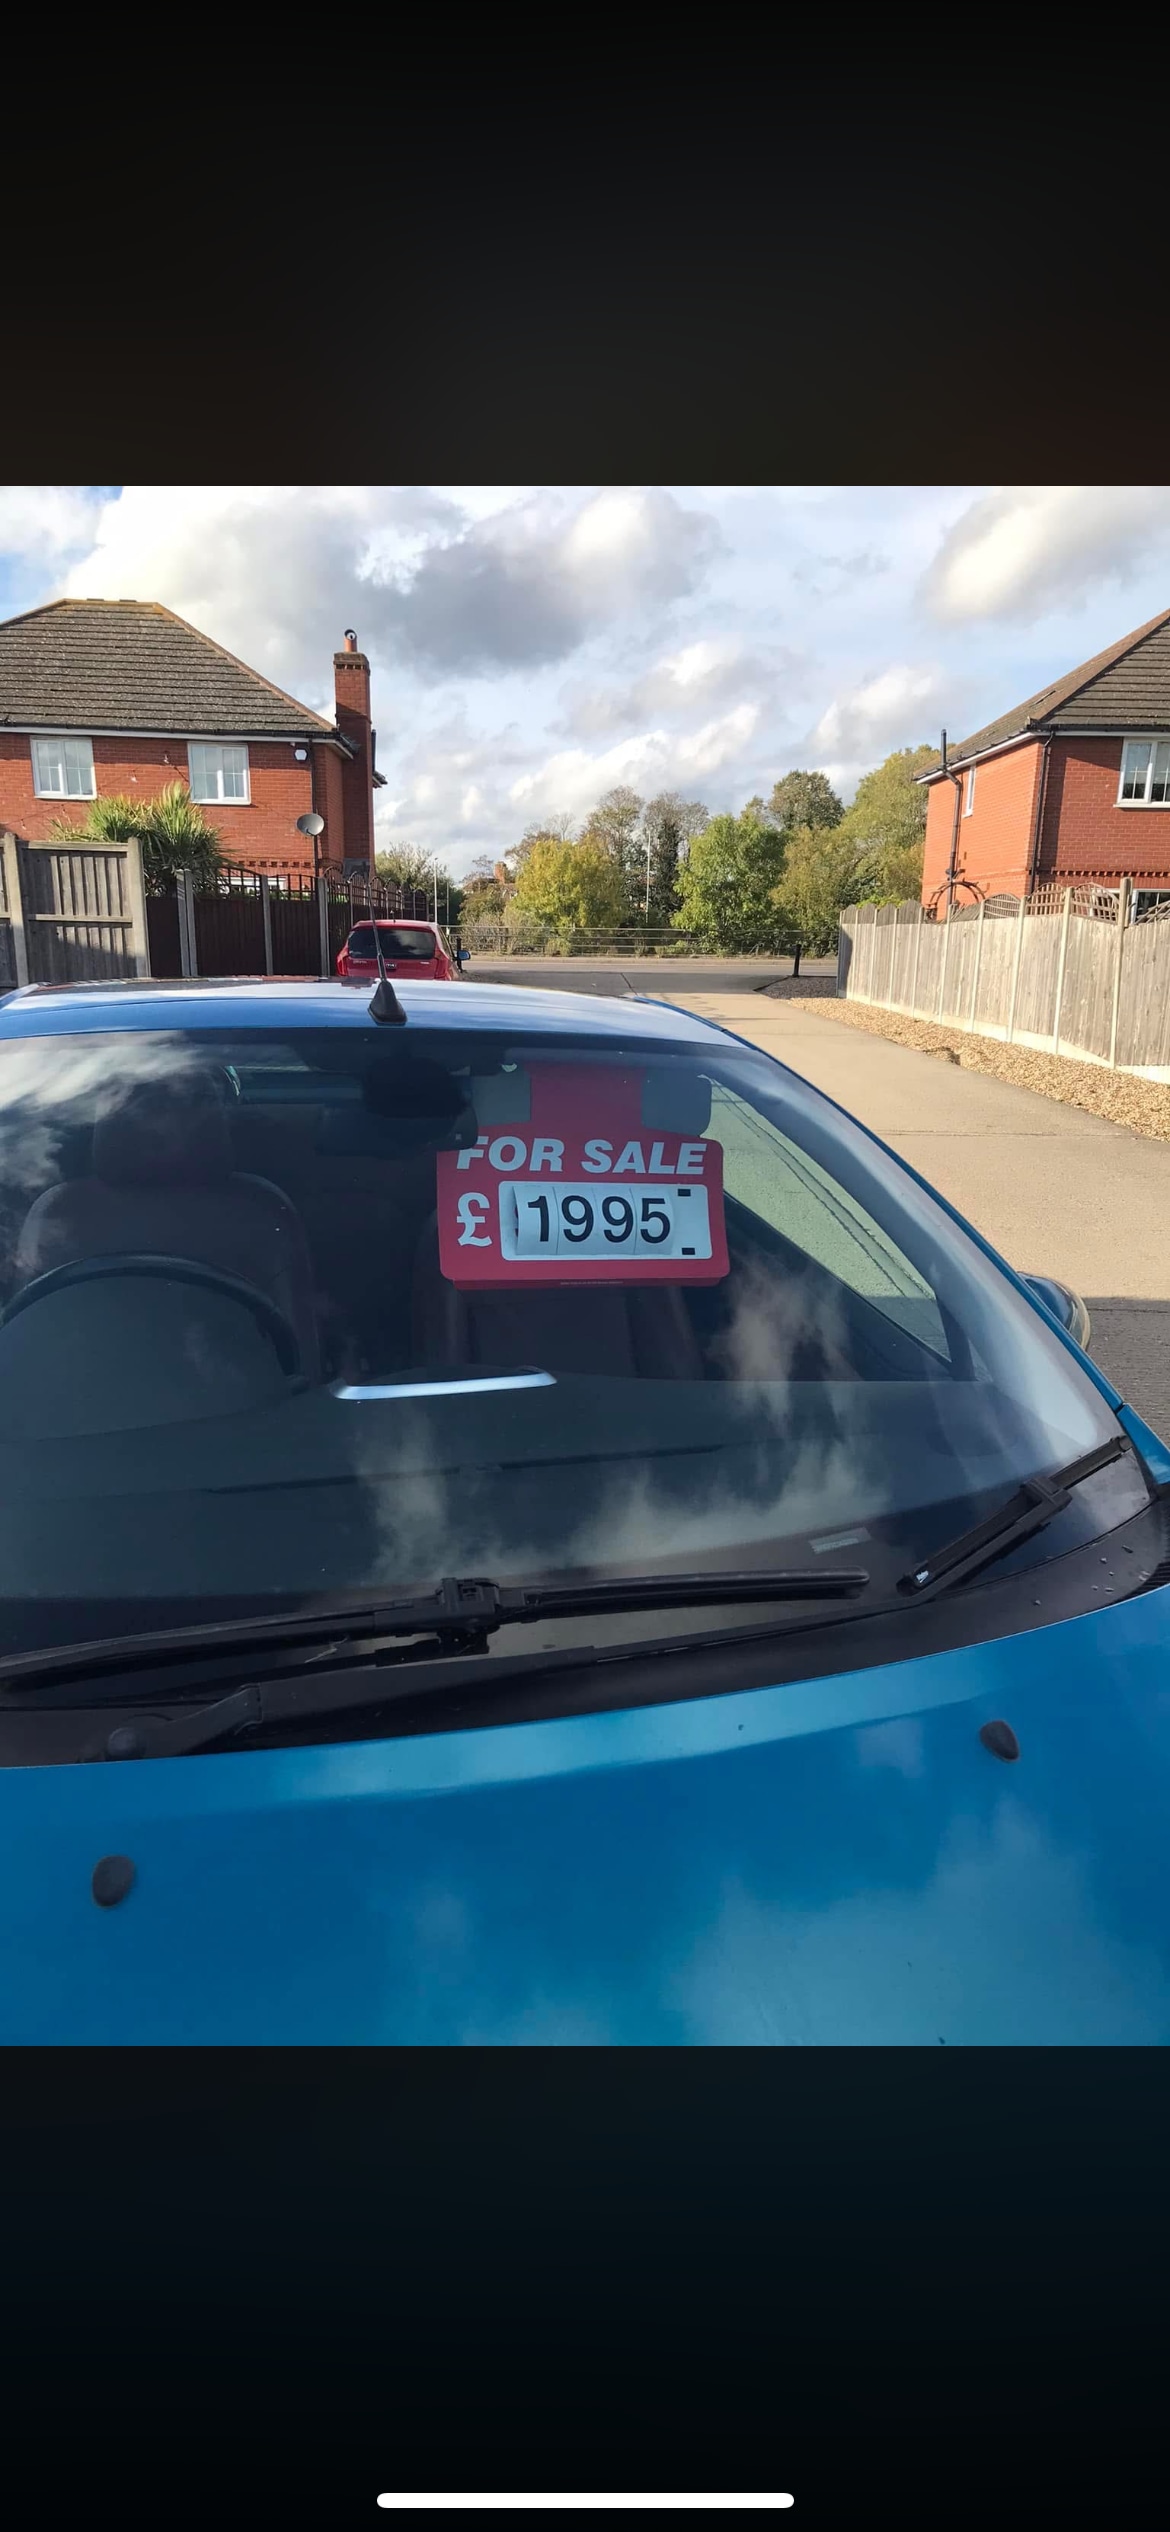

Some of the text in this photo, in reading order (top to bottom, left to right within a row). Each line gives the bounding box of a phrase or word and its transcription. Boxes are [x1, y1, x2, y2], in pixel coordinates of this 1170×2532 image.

[456, 1135, 708, 1175] FOR SALE
[526, 1194, 672, 1244] 1995
